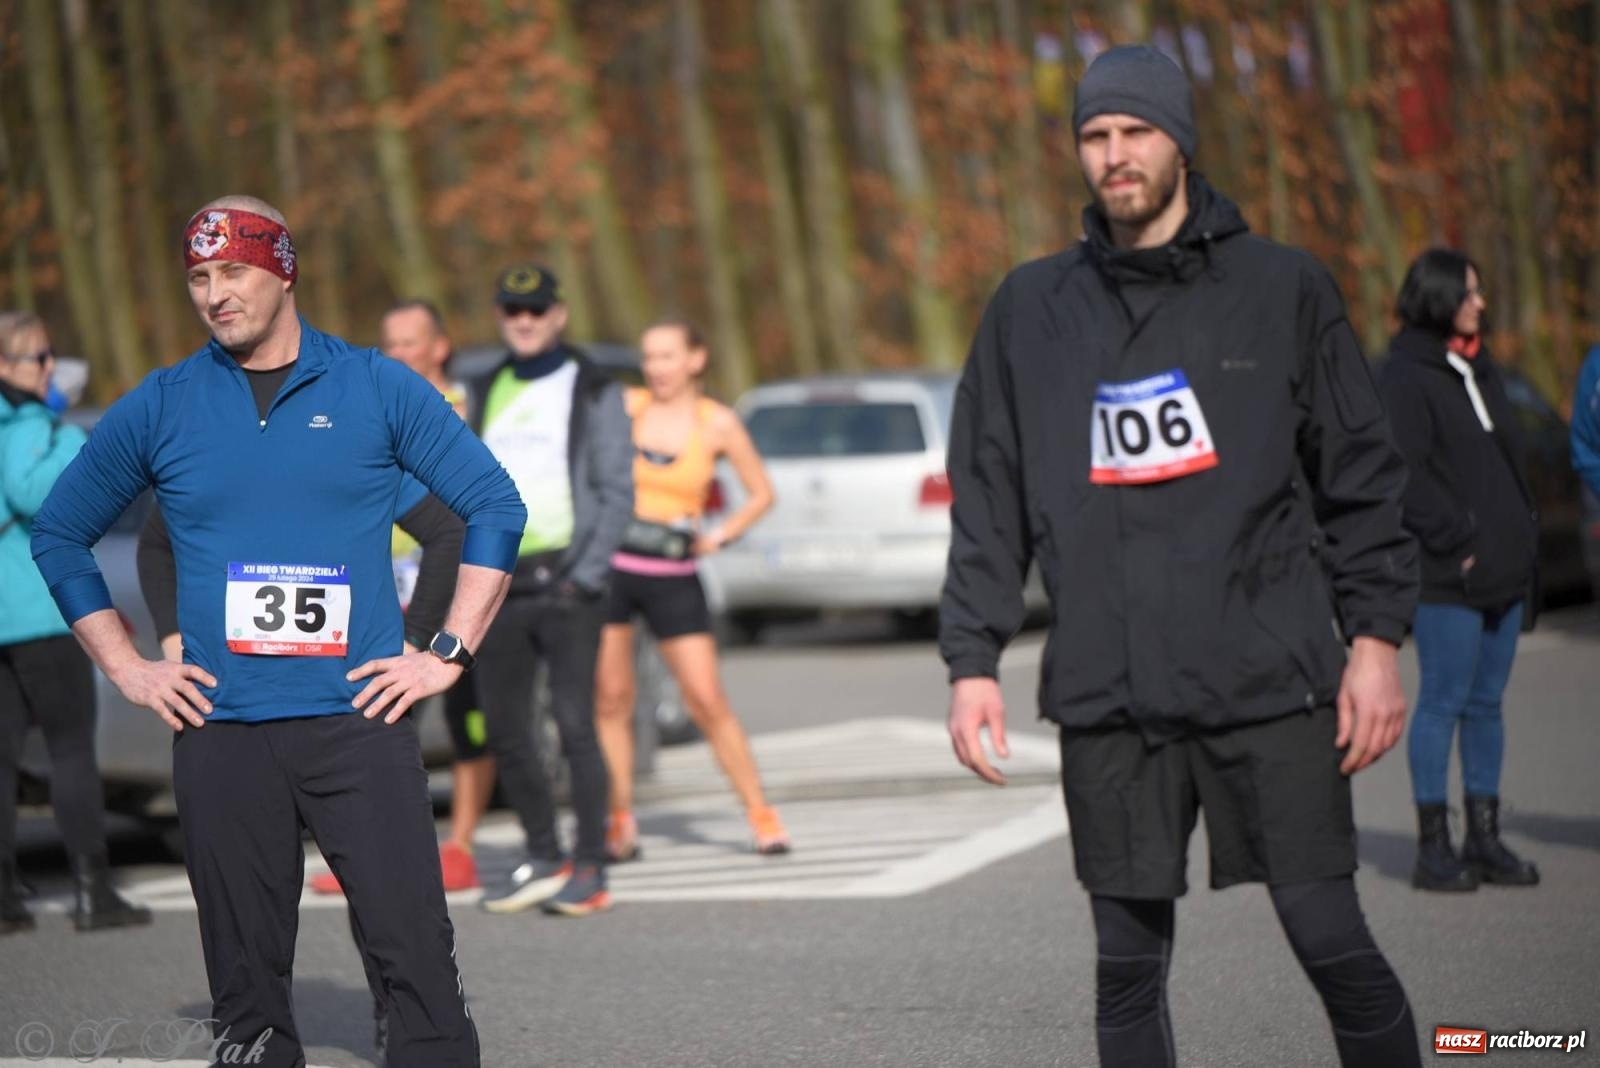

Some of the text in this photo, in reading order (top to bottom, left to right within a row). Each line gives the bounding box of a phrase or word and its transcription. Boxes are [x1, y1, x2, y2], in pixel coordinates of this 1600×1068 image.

[1100, 399, 1192, 457] 106
[243, 565, 338, 576] XII BIEG TWARDZIELA
[253, 585, 326, 633] 35
